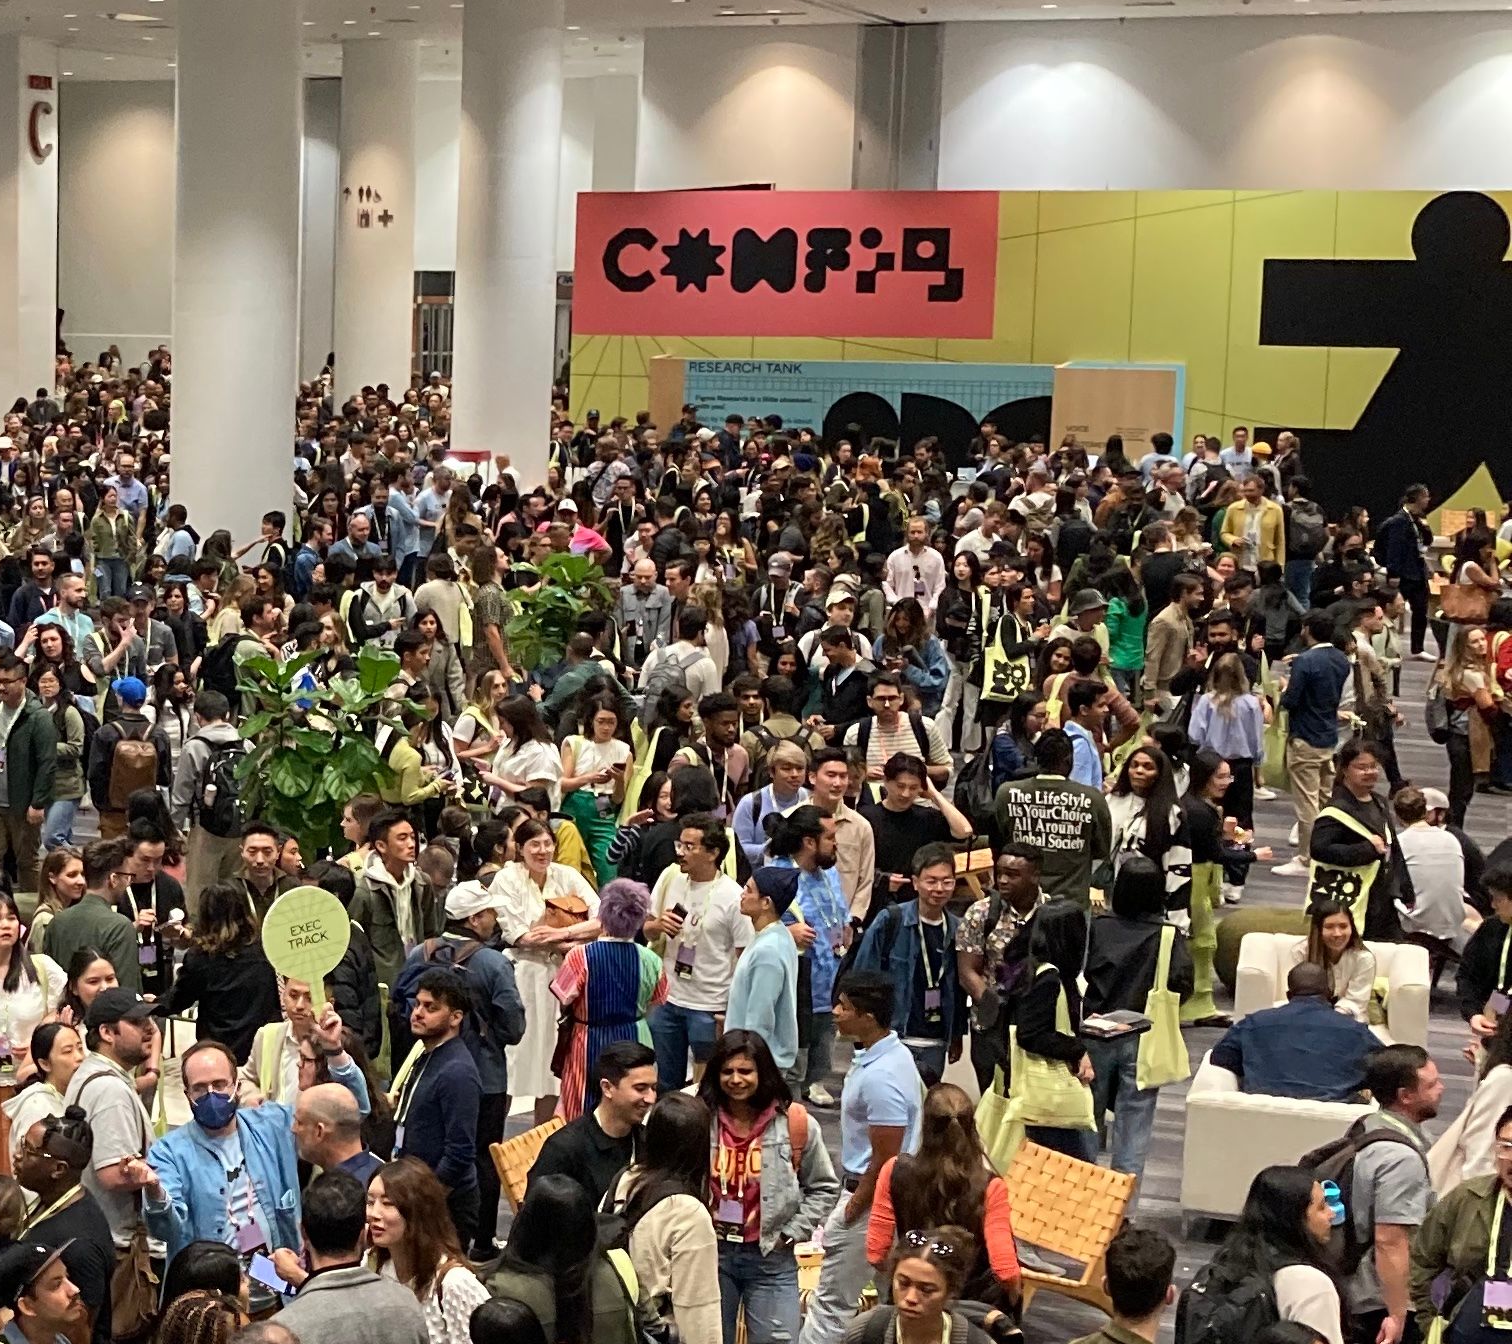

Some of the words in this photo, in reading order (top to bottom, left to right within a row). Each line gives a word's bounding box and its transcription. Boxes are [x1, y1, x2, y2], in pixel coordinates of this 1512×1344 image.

[29, 101, 53, 164] C
[689, 361, 761, 374] RESEARCH
[767, 362, 802, 374] TANK
[1009, 788, 1032, 803] The
[1014, 816, 1032, 831] All
[1036, 818, 1082, 835] Around
[1013, 831, 1045, 847] Global
[1048, 833, 1085, 852] Society
[290, 919, 322, 936] EXEC
[287, 930, 329, 950] TRACK
